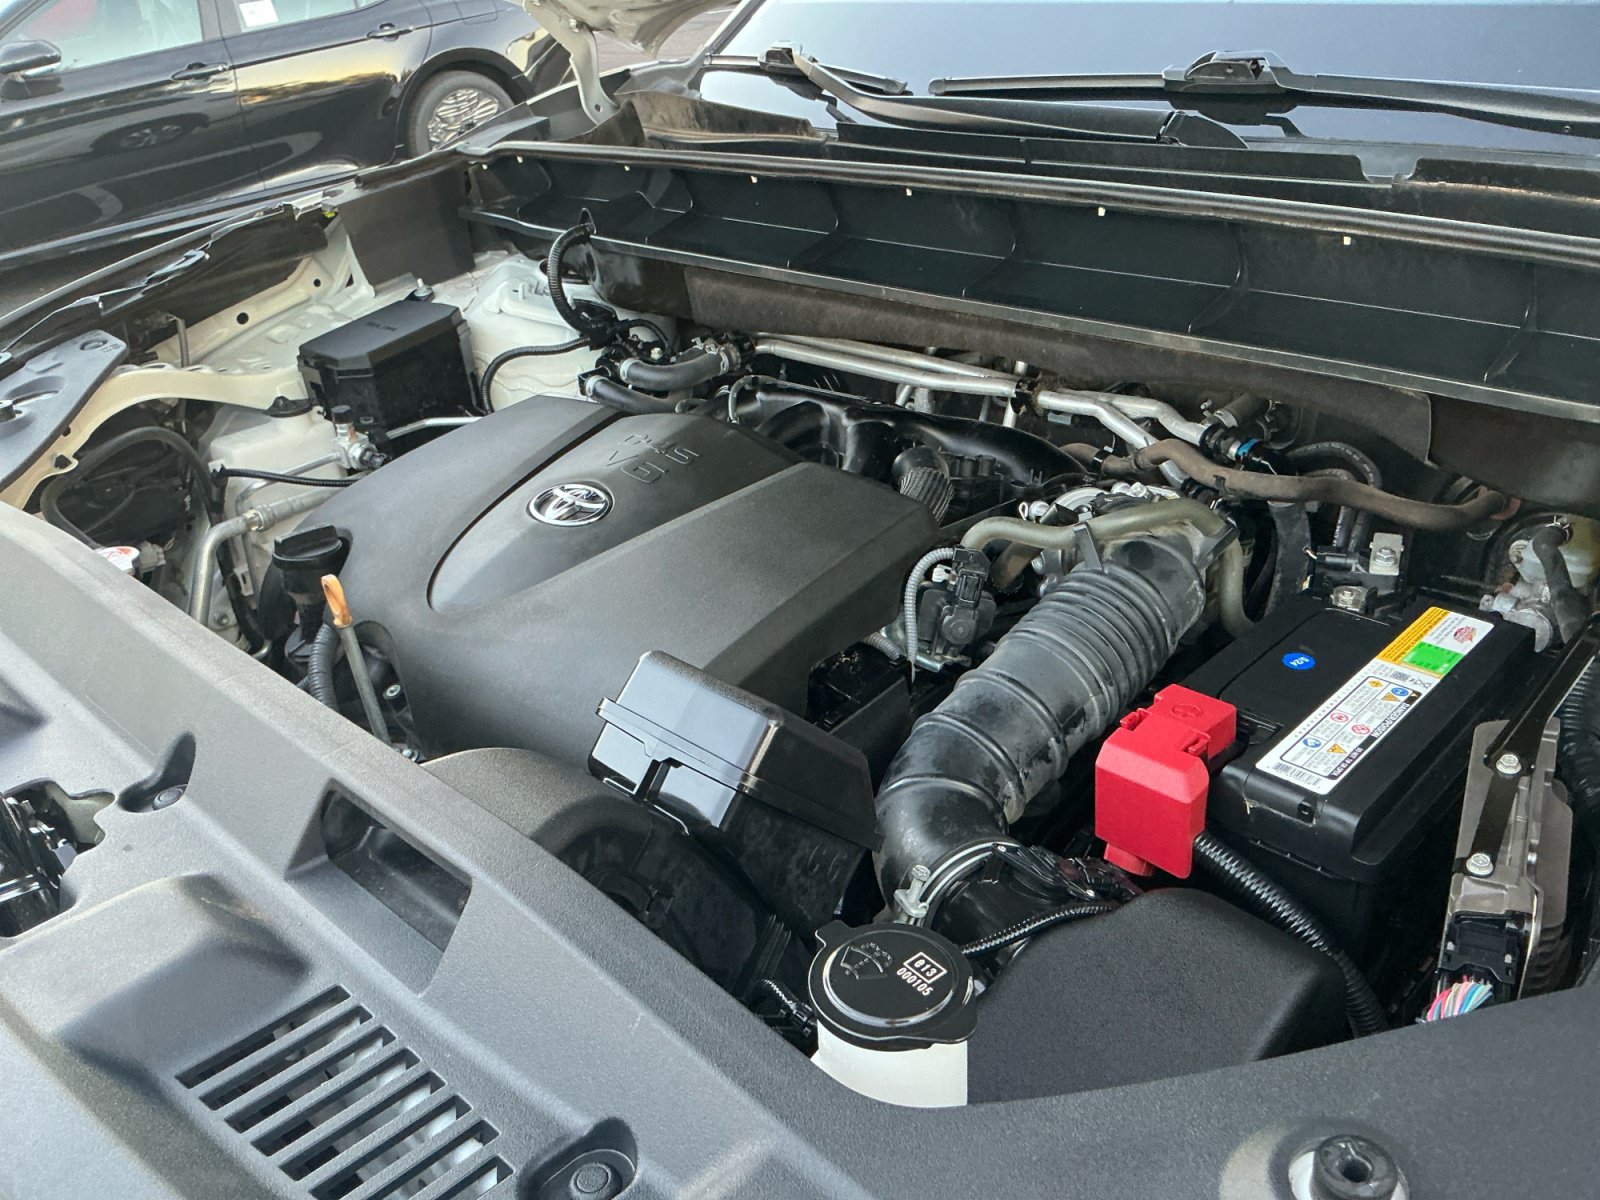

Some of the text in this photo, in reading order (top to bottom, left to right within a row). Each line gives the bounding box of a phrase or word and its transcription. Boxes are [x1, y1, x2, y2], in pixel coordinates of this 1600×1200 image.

[606, 443, 669, 484] V6
[896, 967, 934, 996] 000105
[913, 959, 938, 977] e13
